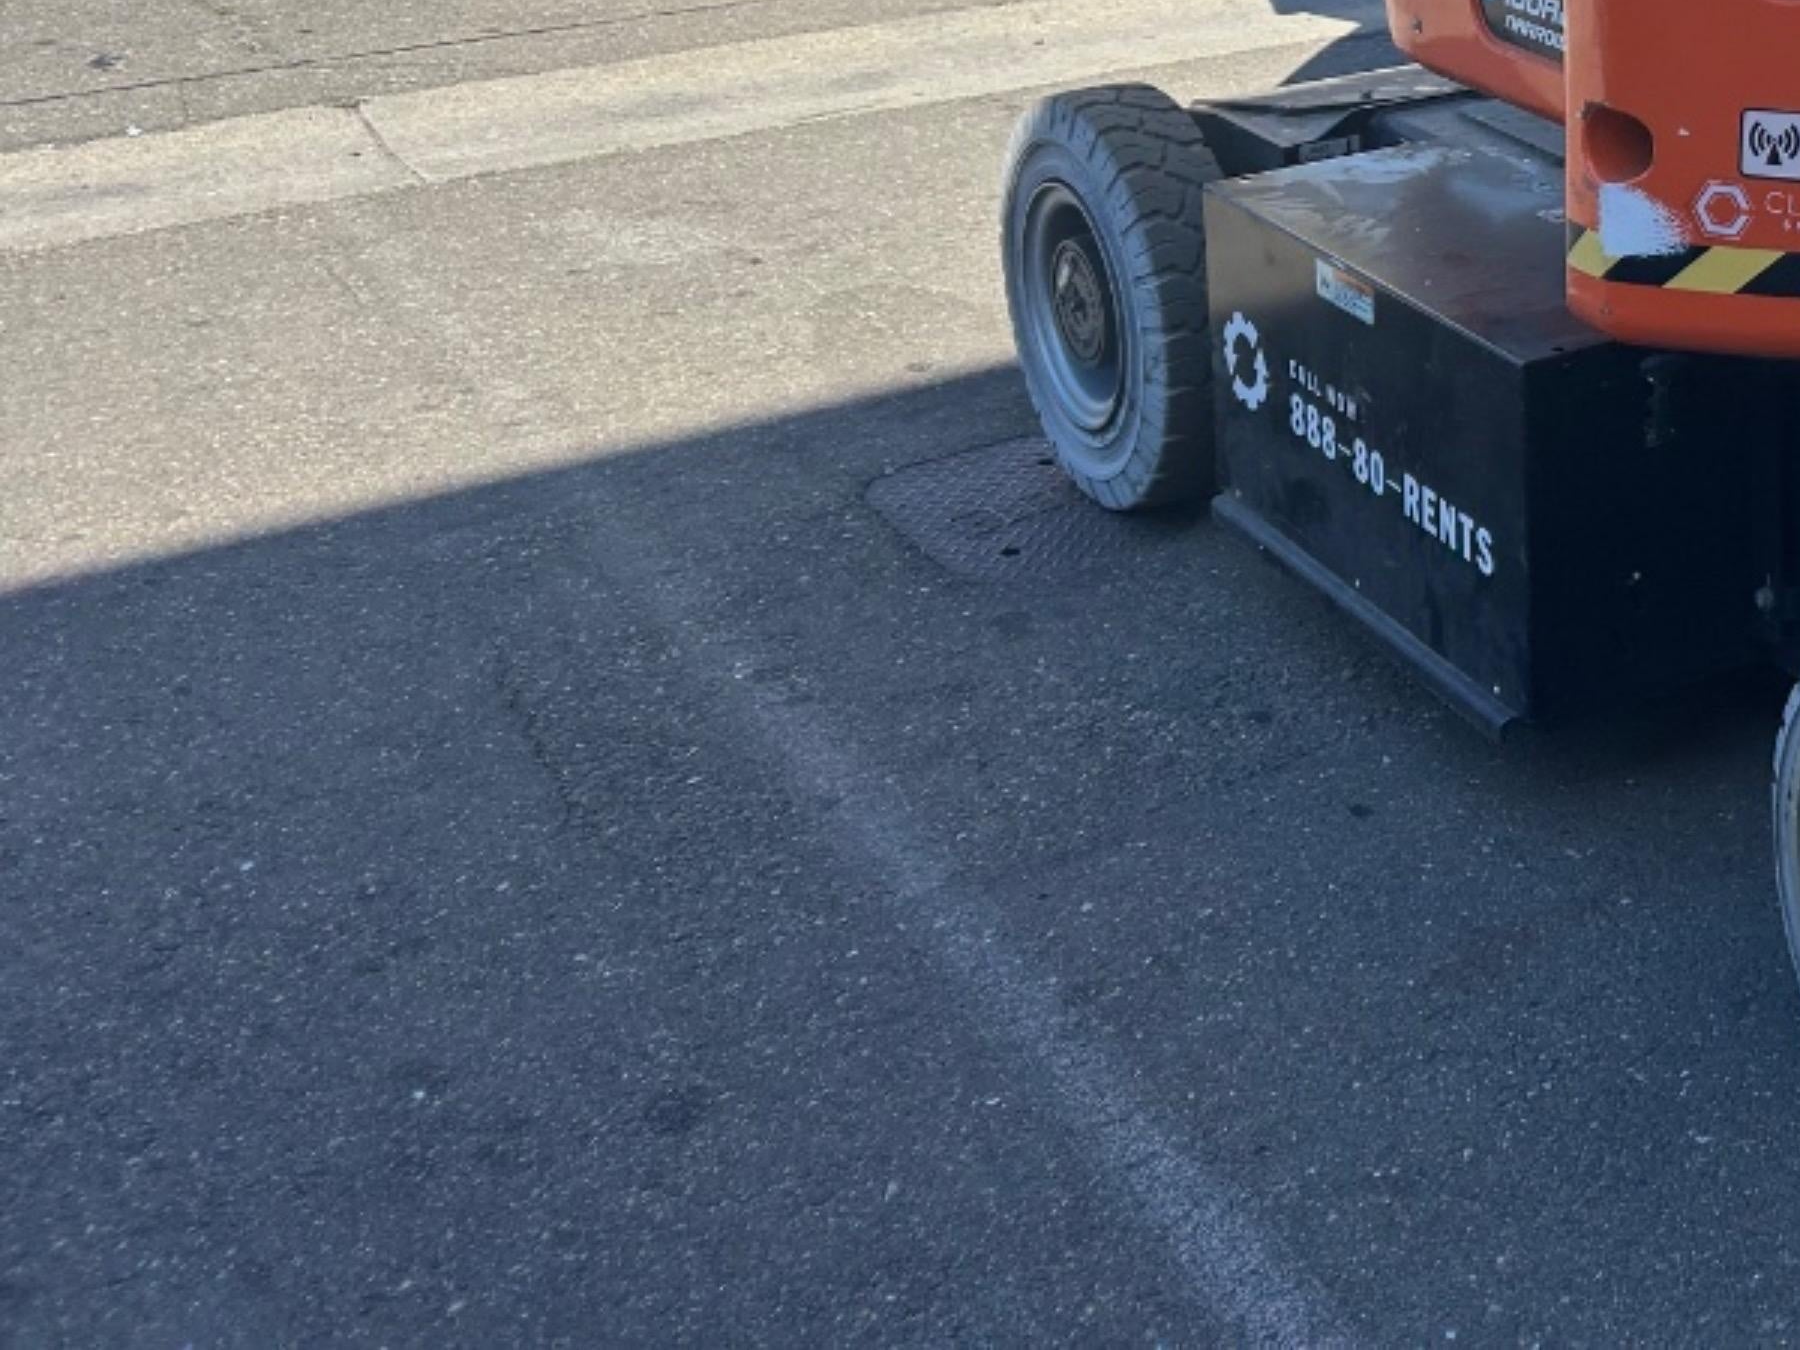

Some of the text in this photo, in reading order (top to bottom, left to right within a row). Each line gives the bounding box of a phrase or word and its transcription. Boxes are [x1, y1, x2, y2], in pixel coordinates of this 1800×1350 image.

[1289, 359, 1357, 421] CALL NOW
[1289, 393, 1494, 577] 888-80-RENTS
